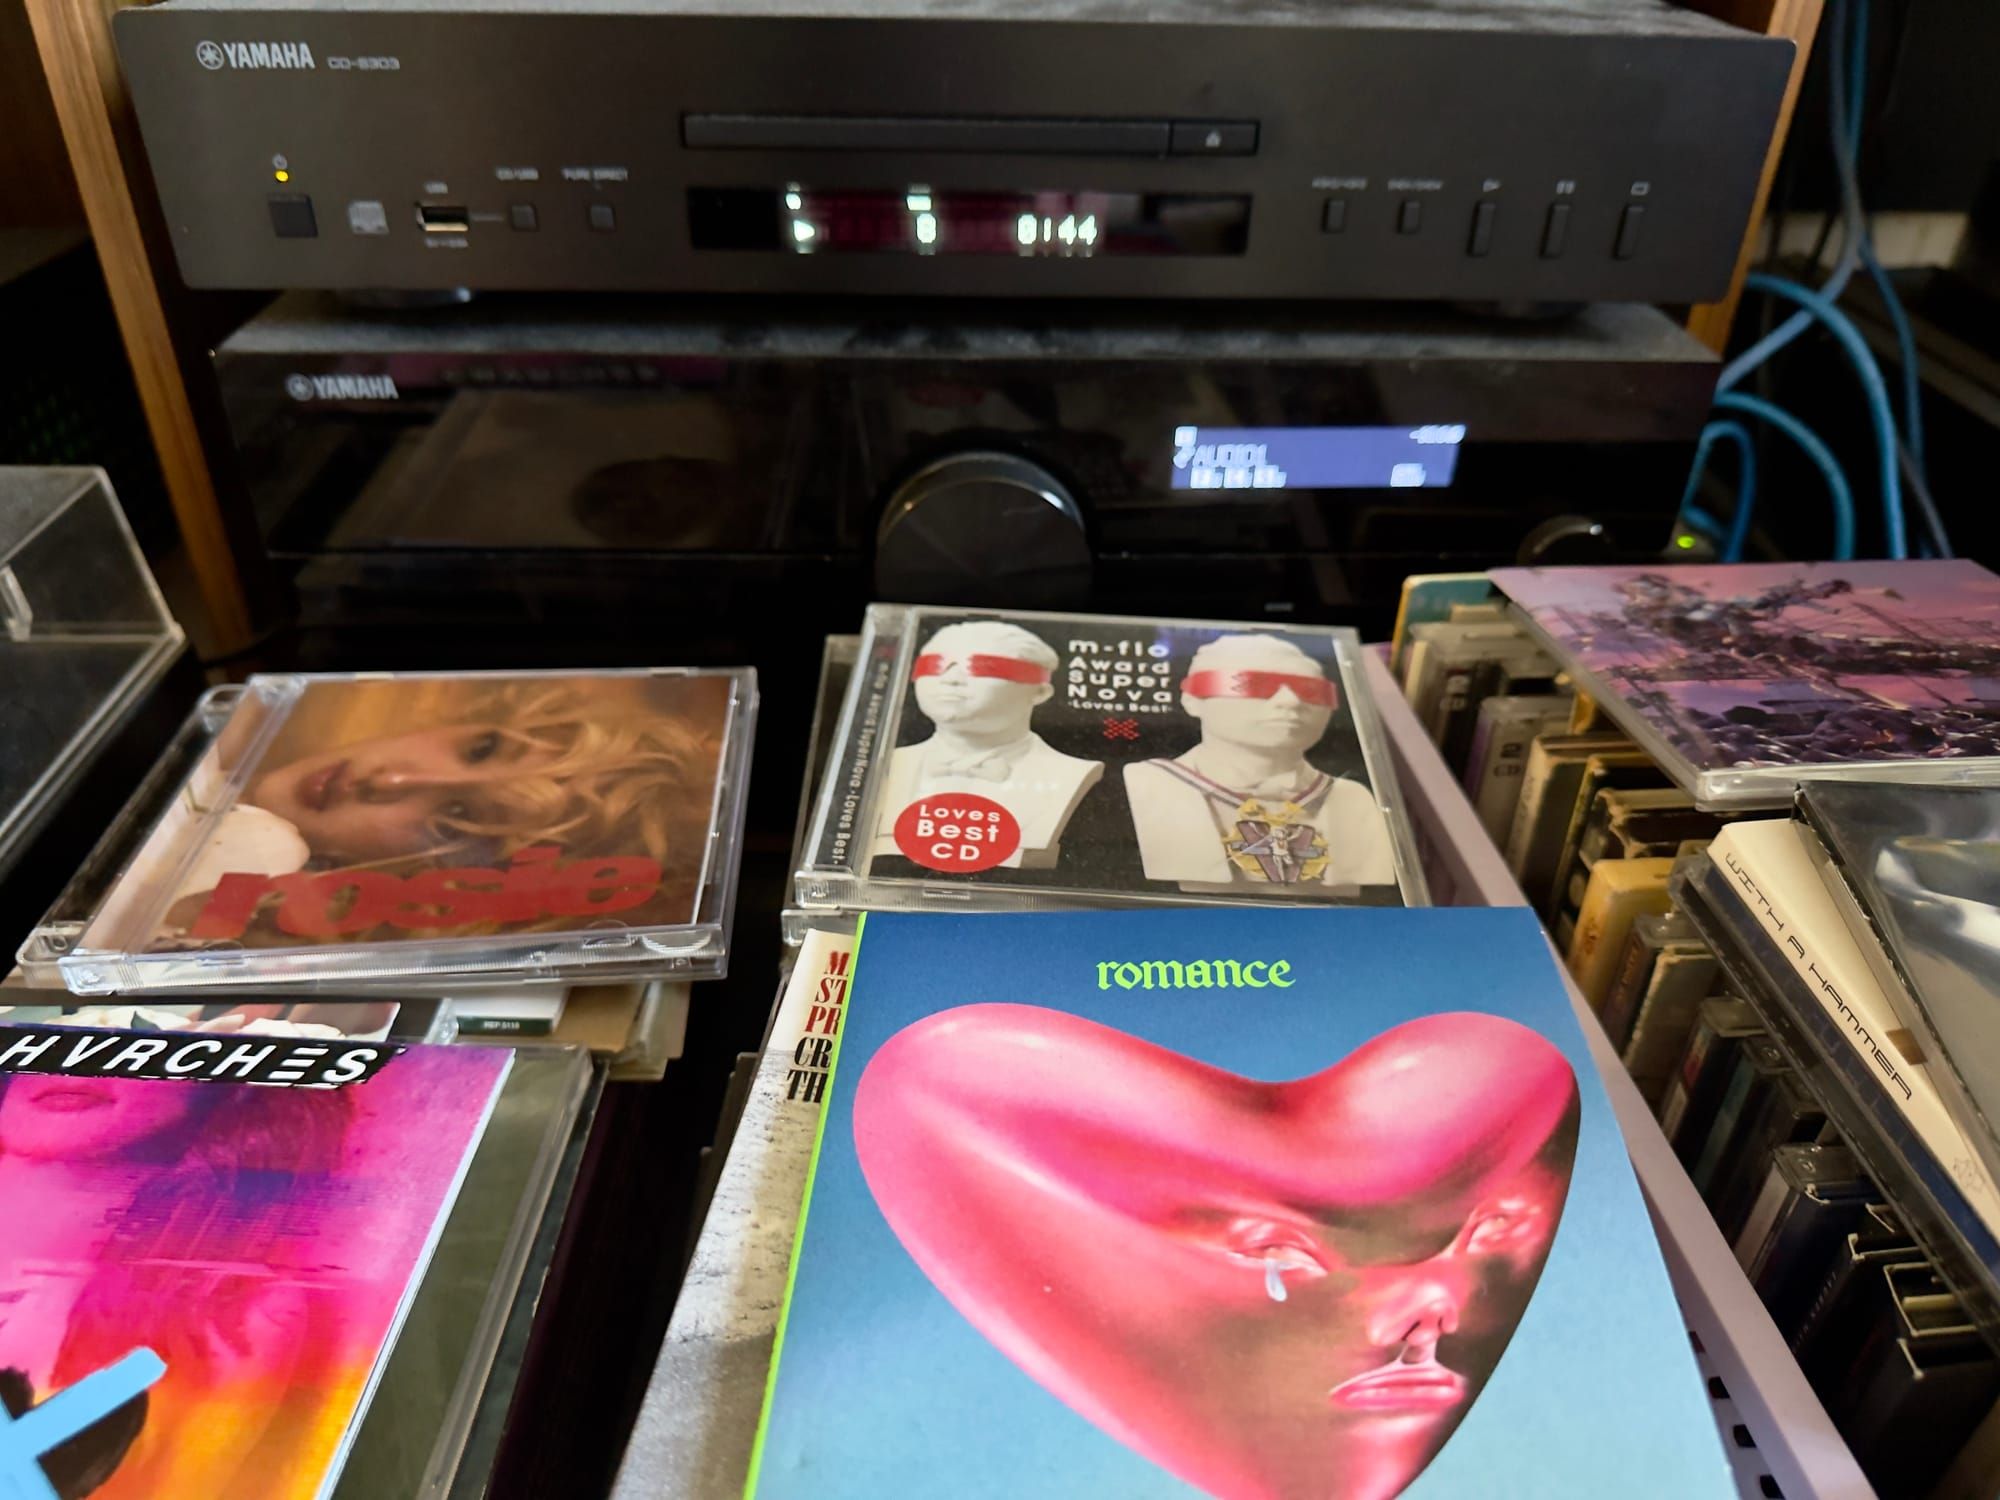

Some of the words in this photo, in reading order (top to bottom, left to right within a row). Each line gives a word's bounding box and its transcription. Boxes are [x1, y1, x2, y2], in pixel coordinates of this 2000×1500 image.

[222, 41, 316, 69] YAMAHA
[311, 374, 400, 400] YAMAHA
[1068, 639, 1169, 658] m-flo
[1068, 656, 1170, 674] Award
[1068, 669, 1170, 689] Super
[1067, 684, 1172, 703] Nova
[919, 803, 1001, 822] Loves
[916, 818, 999, 842] Best
[930, 842, 980, 860] CD
[190, 846, 661, 940] rosie
[1095, 959, 1297, 991] romance
[1724, 852, 1785, 931] WITH
[1786, 935, 1806, 959] A
[1808, 963, 1913, 1101] HAMMER
